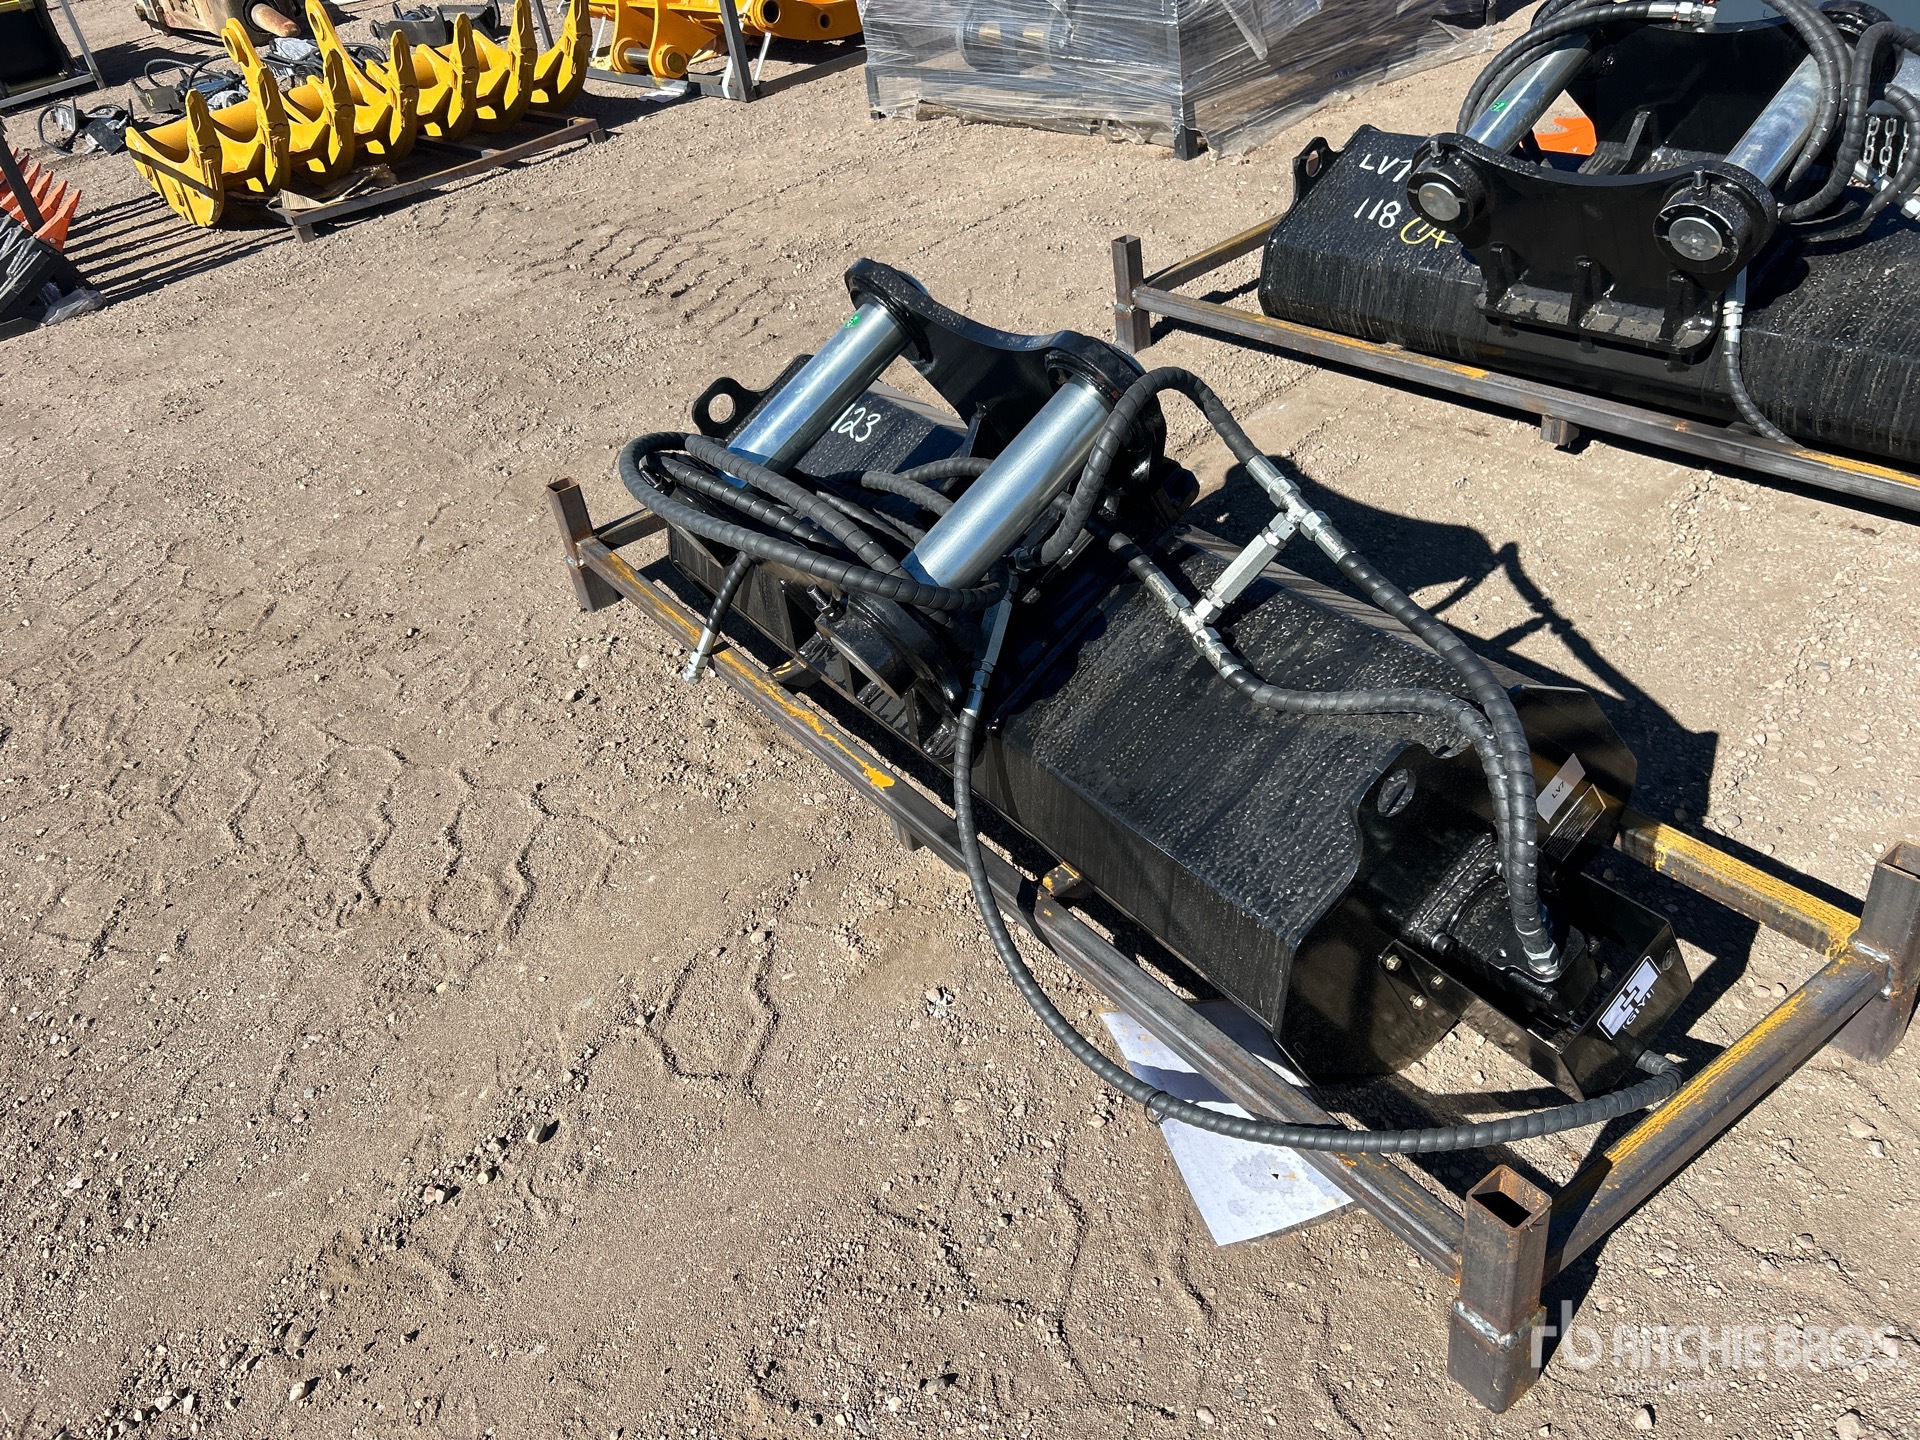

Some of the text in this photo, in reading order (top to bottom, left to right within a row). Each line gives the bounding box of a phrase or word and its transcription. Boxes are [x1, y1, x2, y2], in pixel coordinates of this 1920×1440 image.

[1353, 197, 1402, 229] 118
[830, 403, 882, 443] 123
[1551, 780, 1565, 799] LV7
